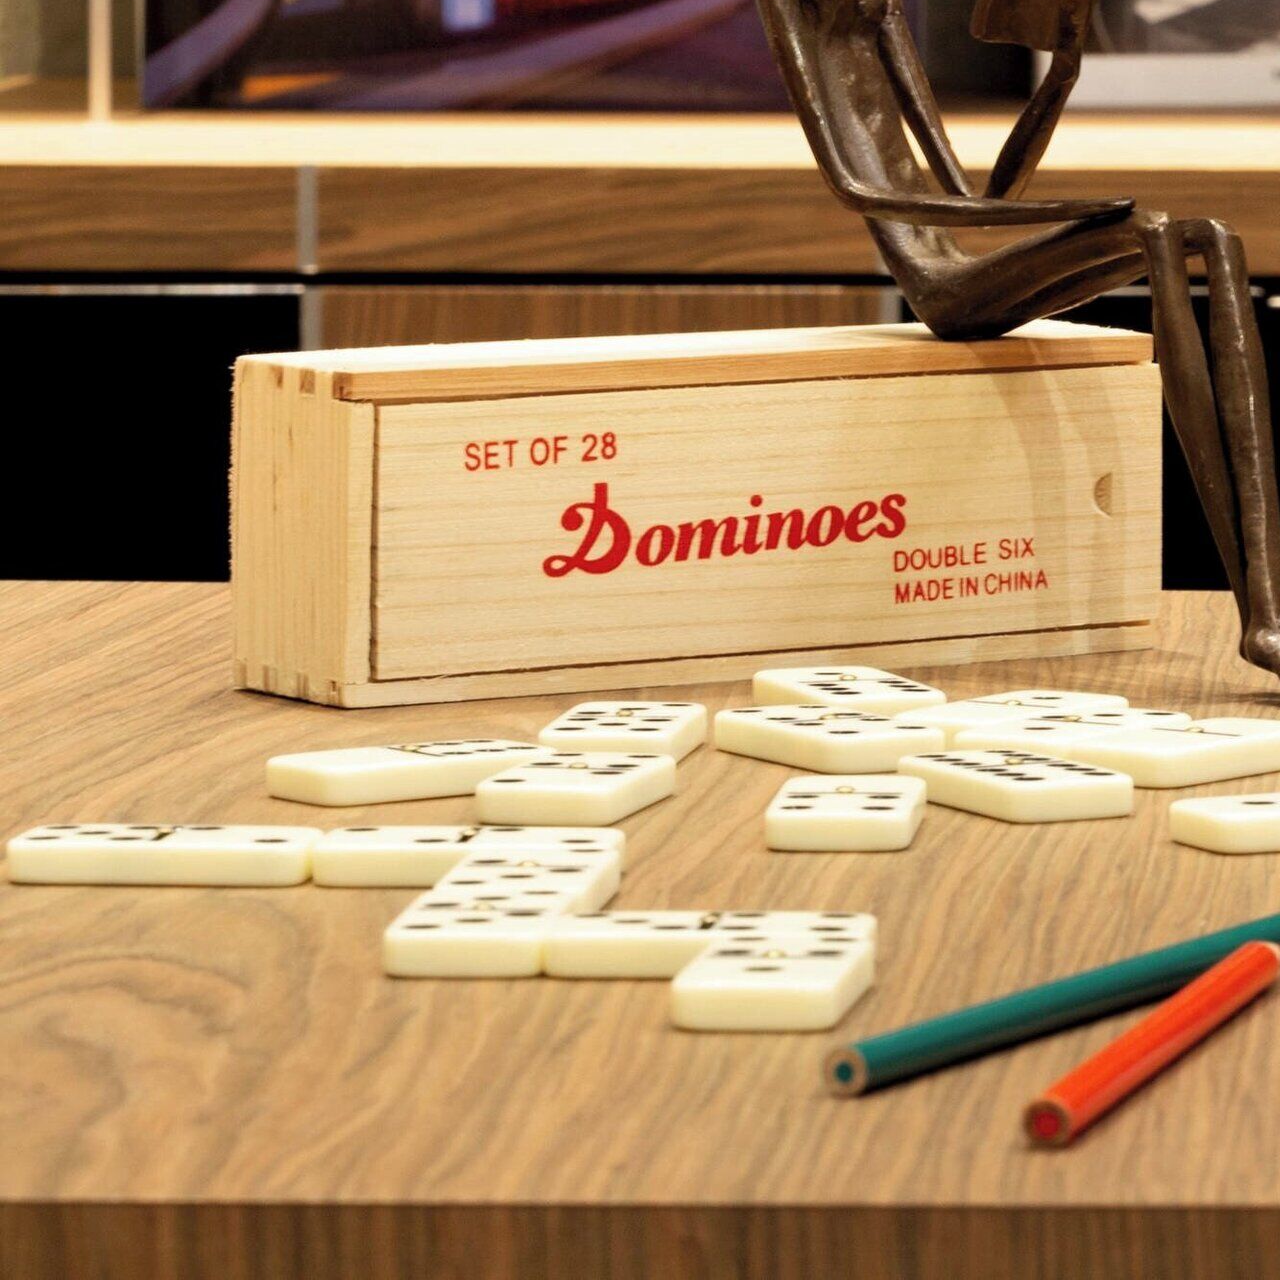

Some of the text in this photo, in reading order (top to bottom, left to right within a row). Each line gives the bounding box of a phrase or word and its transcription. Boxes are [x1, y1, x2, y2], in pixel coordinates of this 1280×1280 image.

[464, 431, 617, 471] SET OF 28
[542, 482, 907, 578] Dominoes
[893, 537, 1035, 573] DOUBLE SIX
[894, 569, 1049, 604] MADE IN CHINA
